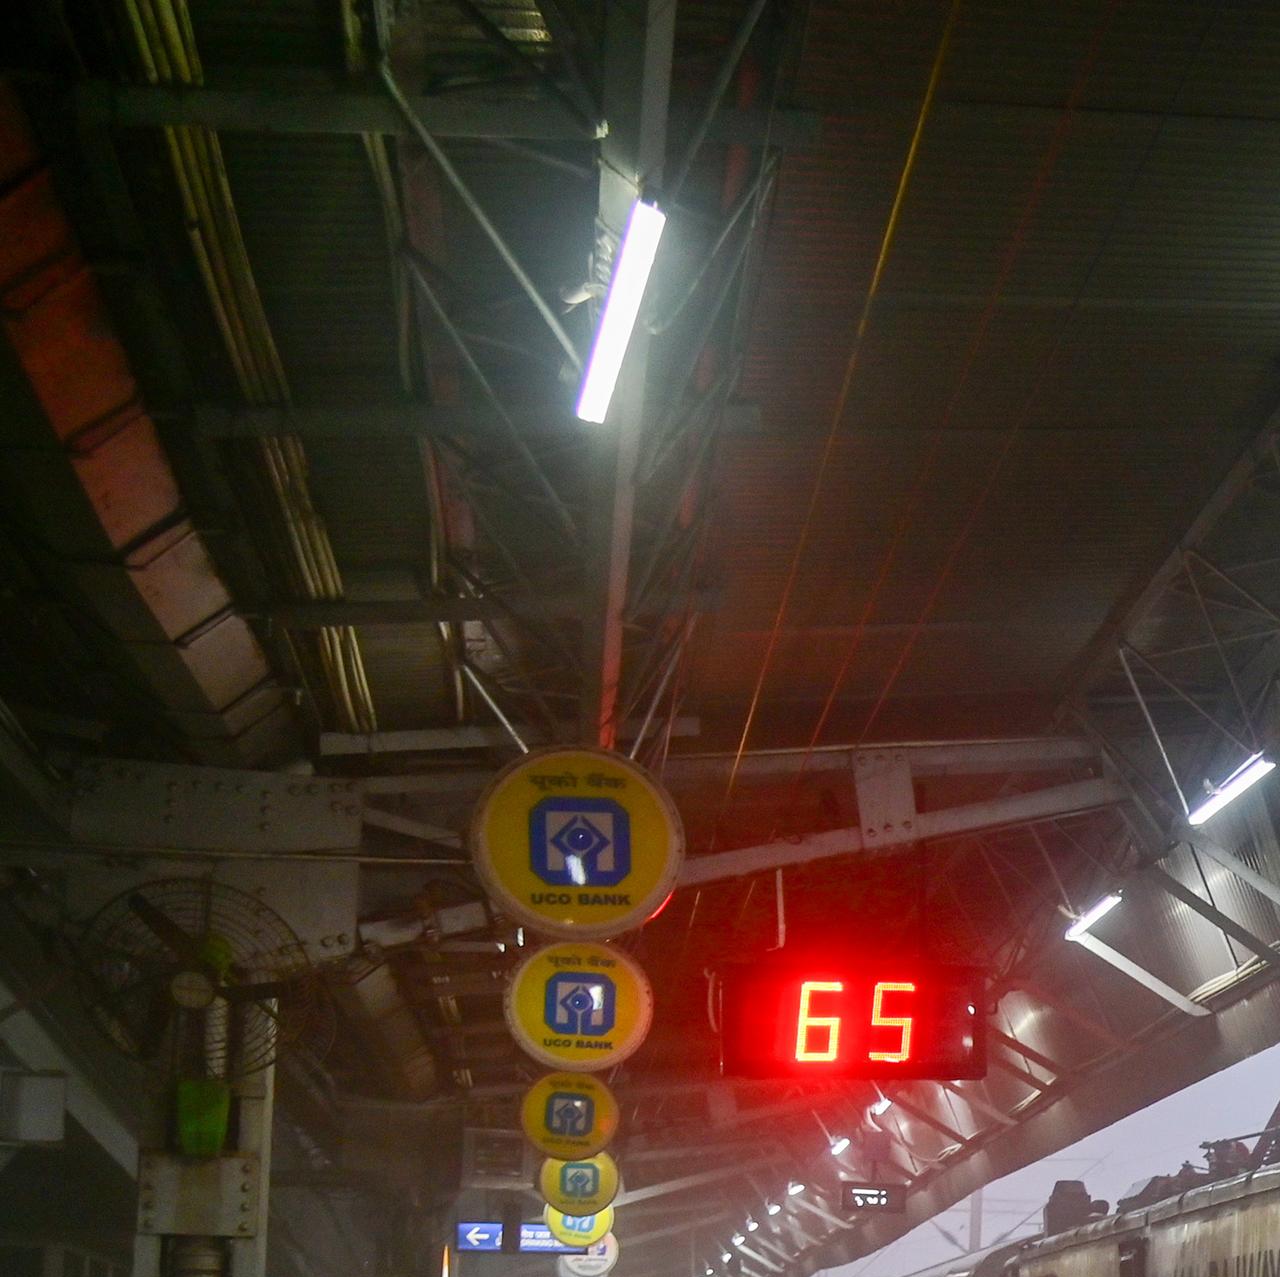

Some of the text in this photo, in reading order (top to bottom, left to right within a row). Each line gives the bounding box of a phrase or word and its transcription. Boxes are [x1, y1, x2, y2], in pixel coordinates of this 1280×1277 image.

[531, 892, 632, 906] UCO BANK
[543, 1037, 614, 1050] UCO BANK
